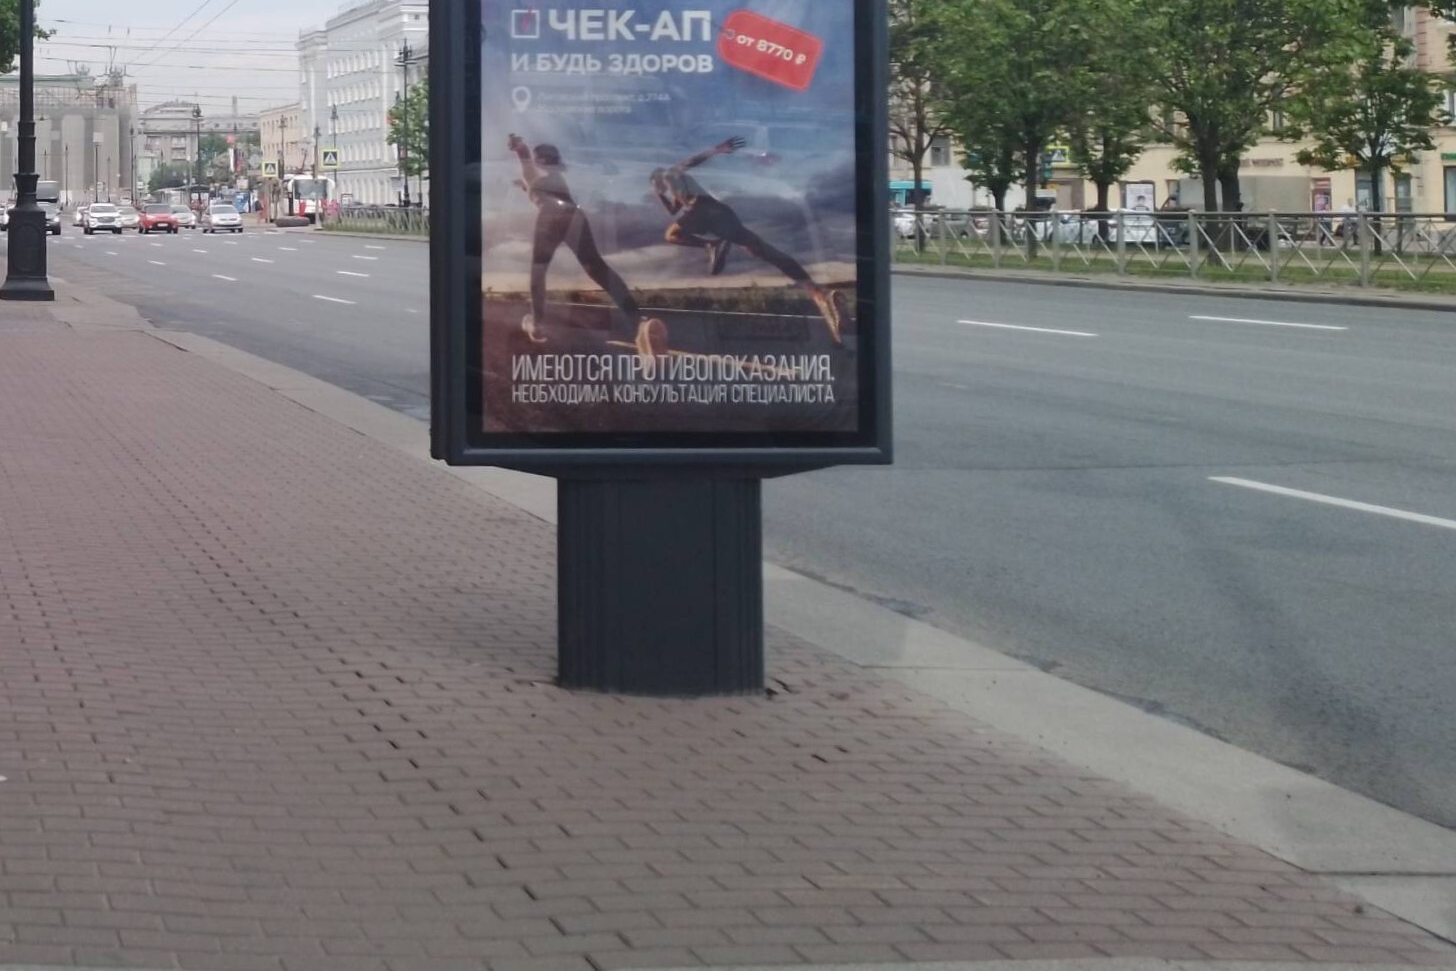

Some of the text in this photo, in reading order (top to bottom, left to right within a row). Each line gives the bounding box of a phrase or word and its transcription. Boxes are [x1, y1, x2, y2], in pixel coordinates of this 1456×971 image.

[548, 10, 712, 42] ЧЕК-АП
[736, 32, 756, 47] от
[756, 38, 794, 62] 8770
[510, 53, 714, 75] И БУДЬ ЗДОРОВ
[512, 354, 835, 382] ИМЕЮТСЯ ПРОТИВОПОКАЗАНИЯ.
[512, 384, 835, 405] НЕОБХОДИМА КОНСУЛЬТАЦИЯ СПЕЦИАЛИСТА
